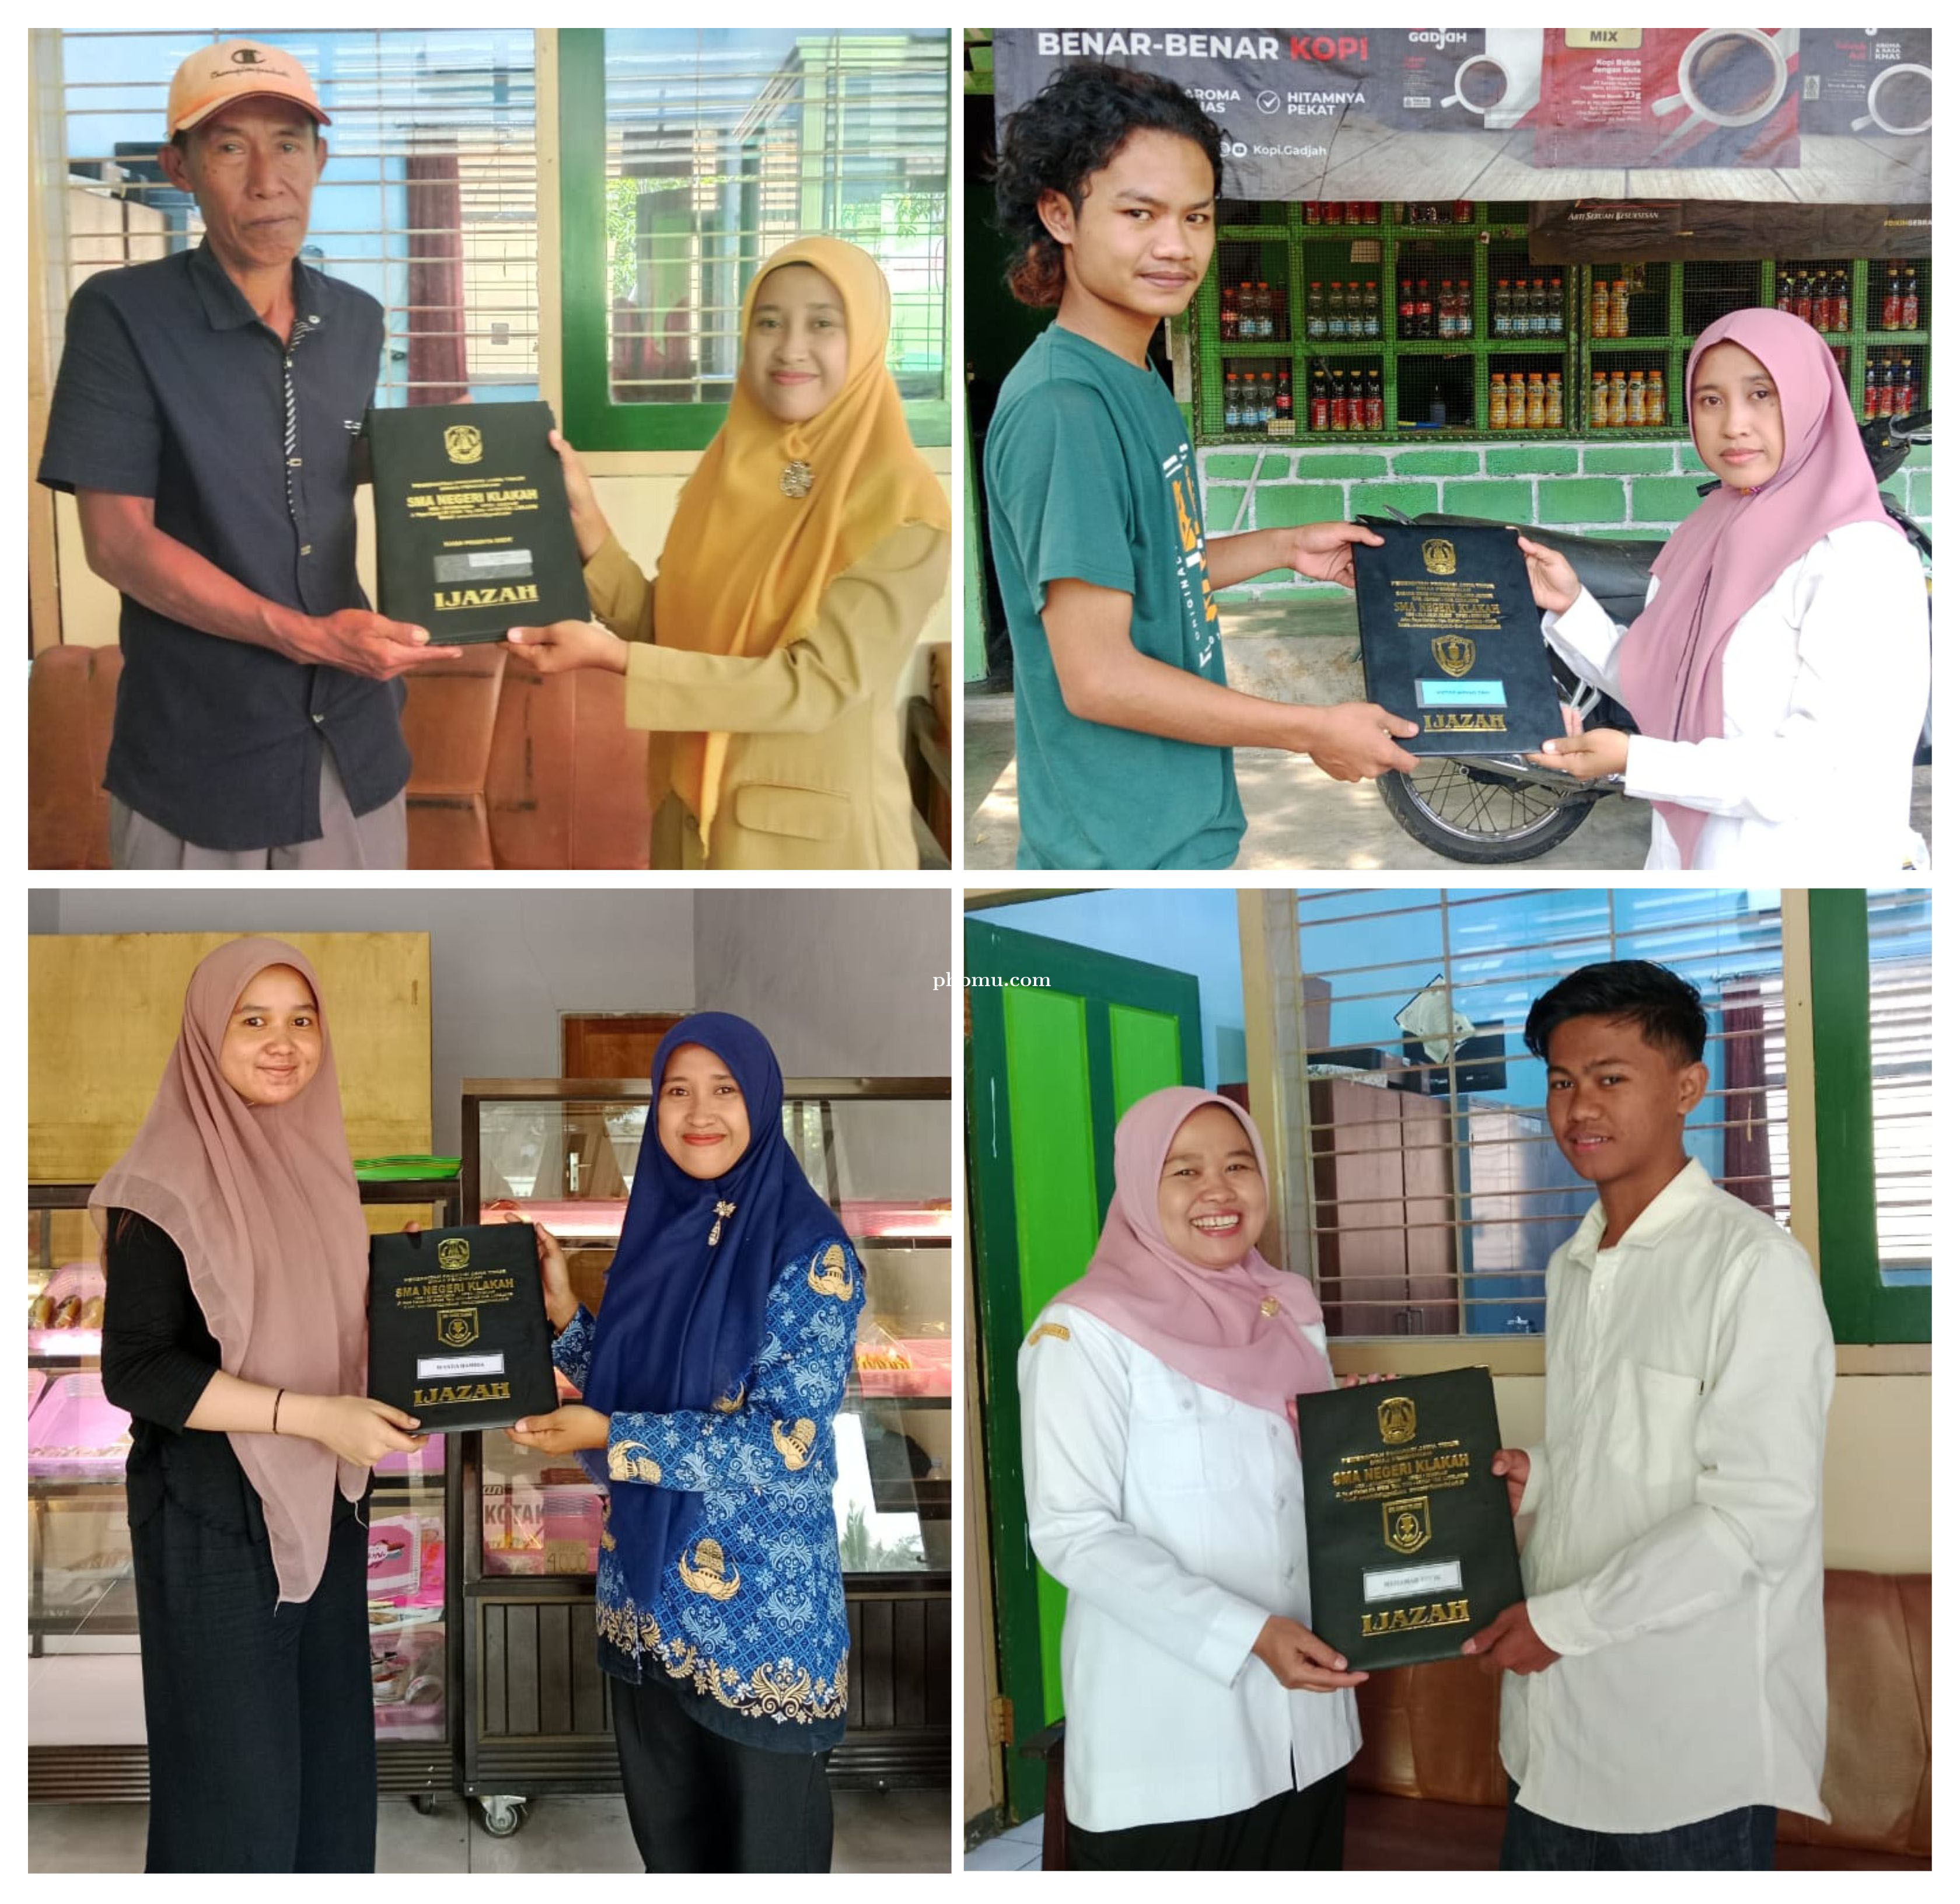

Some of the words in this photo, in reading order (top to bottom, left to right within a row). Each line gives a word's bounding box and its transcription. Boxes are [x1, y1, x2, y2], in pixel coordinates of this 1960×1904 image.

[1038, 32, 1278, 60] BENAR-BENAR
[1290, 36, 1368, 61] KOPI
[1589, 31, 1618, 42] MIX
[1287, 92, 1365, 104] HITAMNYA
[1288, 104, 1336, 116] PEKAT
[406, 495, 435, 508] SMA
[436, 492, 485, 505] NEGERI
[485, 488, 539, 502] KLAKAH
[434, 584, 540, 610] IJAZAH
[1393, 602, 1416, 612] SMA
[1419, 603, 1455, 613] NEGERI
[1458, 603, 1501, 614] KLAKAH
[1423, 714, 1507, 732] IJAZAH
[396, 1287, 420, 1298] SMA
[422, 1283, 465, 1295] NEGERI
[468, 1278, 514, 1291] KLAKAH
[414, 1382, 511, 1407] IJAZAH
[1333, 1470, 1361, 1486] SMA
[1364, 1462, 1412, 1480] NEGERI
[1416, 1453, 1469, 1472] KLAKAH
[1361, 1599, 1470, 1637] IJAZAH
